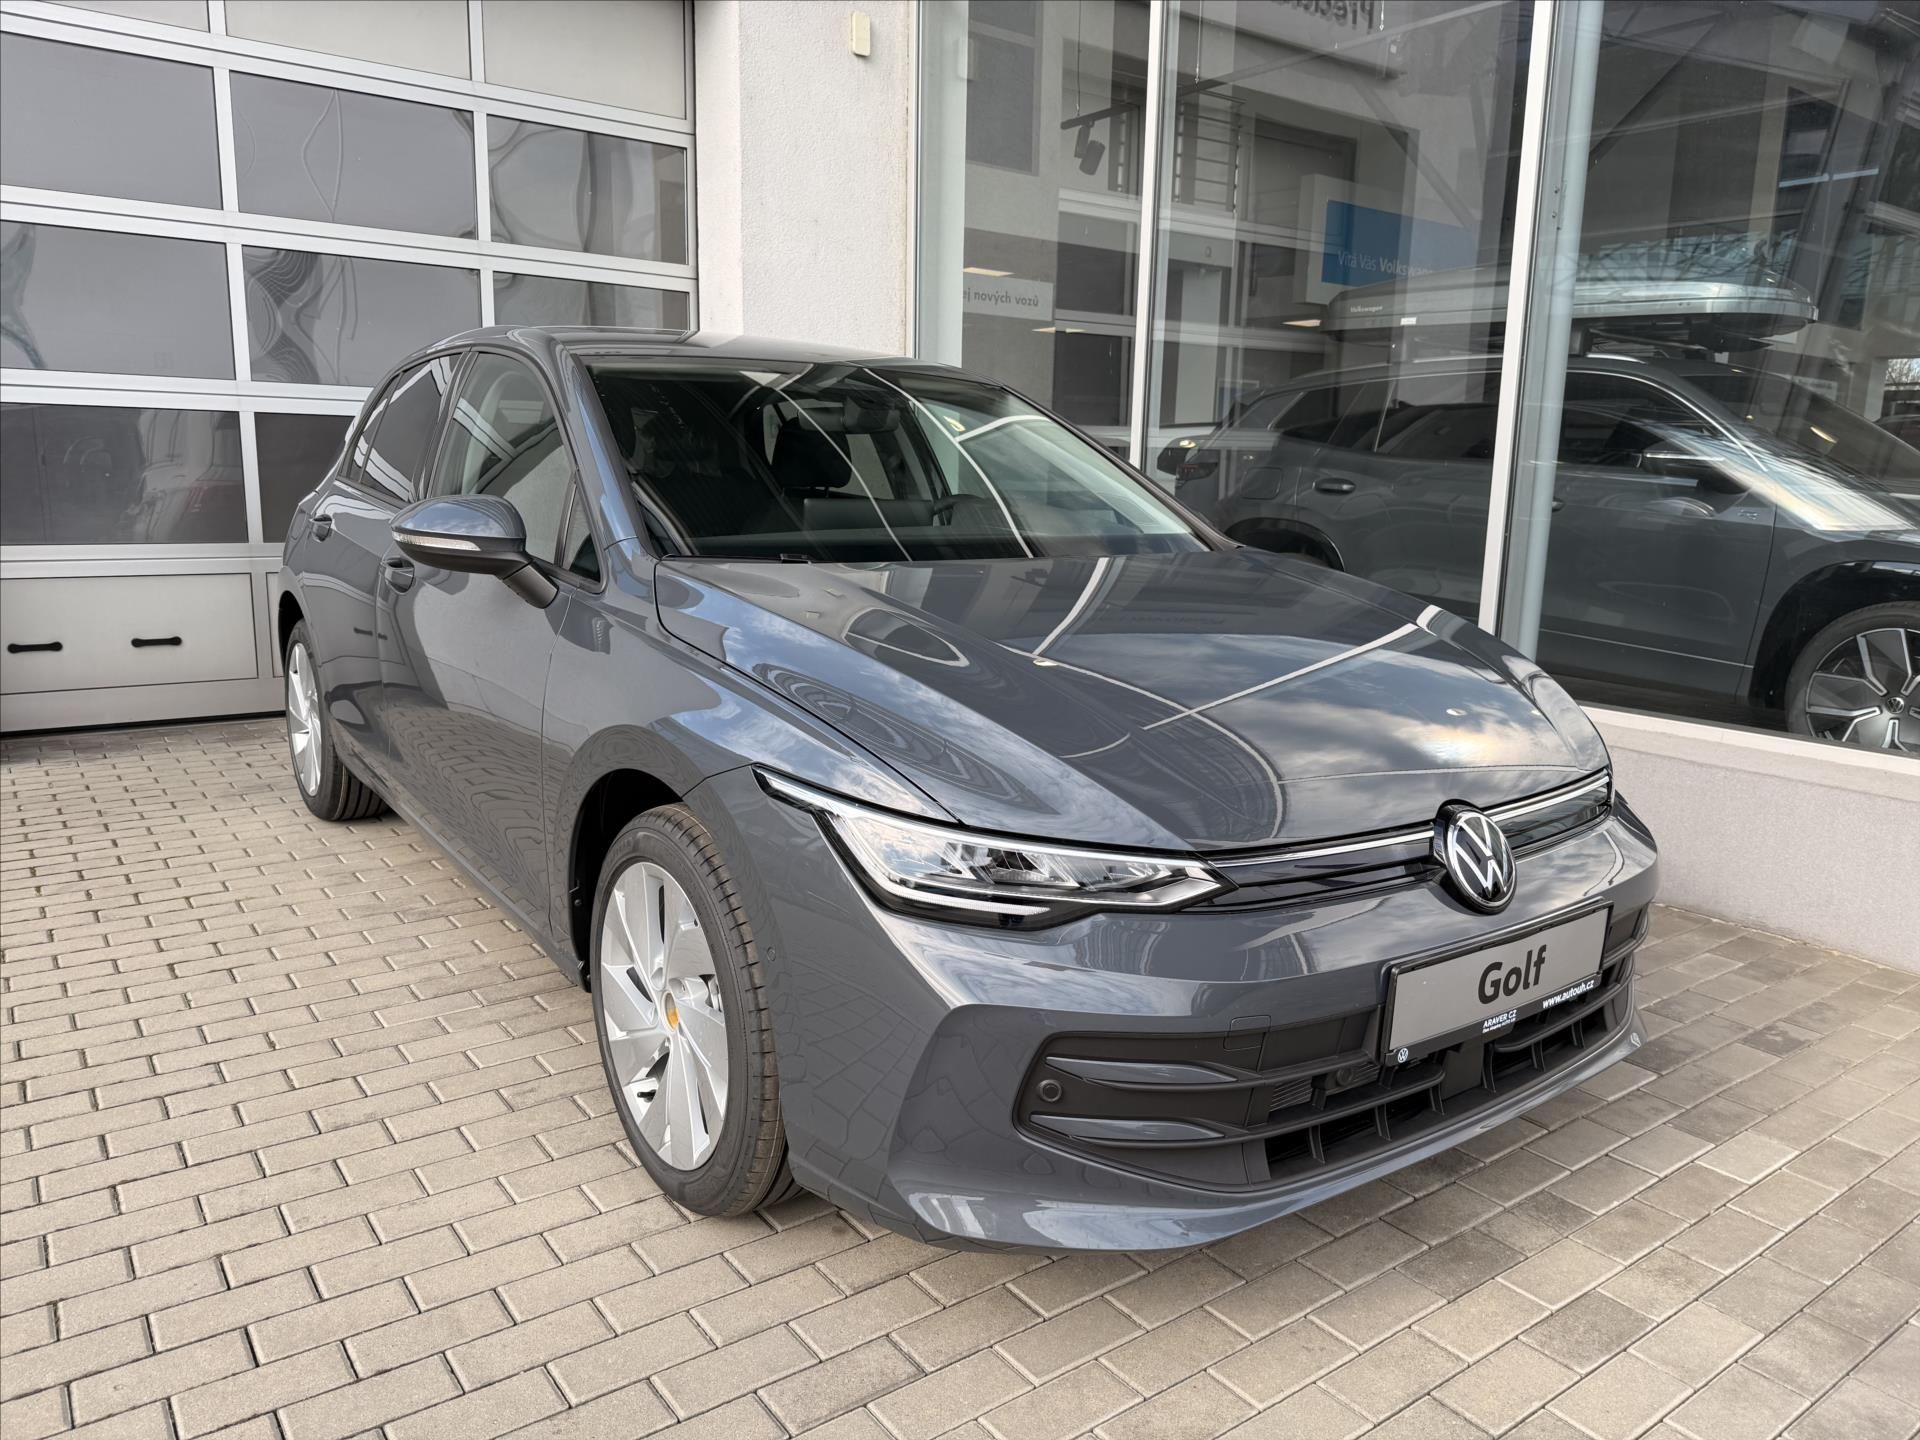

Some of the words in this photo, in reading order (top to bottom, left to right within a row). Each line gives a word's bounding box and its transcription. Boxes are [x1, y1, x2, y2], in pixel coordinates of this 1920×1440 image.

[974, 290, 1011, 306] nových
[1015, 294, 1039, 307] vozů
[1478, 944, 1547, 1004] Golf
[1542, 980, 1595, 1009] www.autouh.cz
[1483, 1013, 1508, 1029] ARAVER
[1508, 1009, 1517, 1019] CZ
